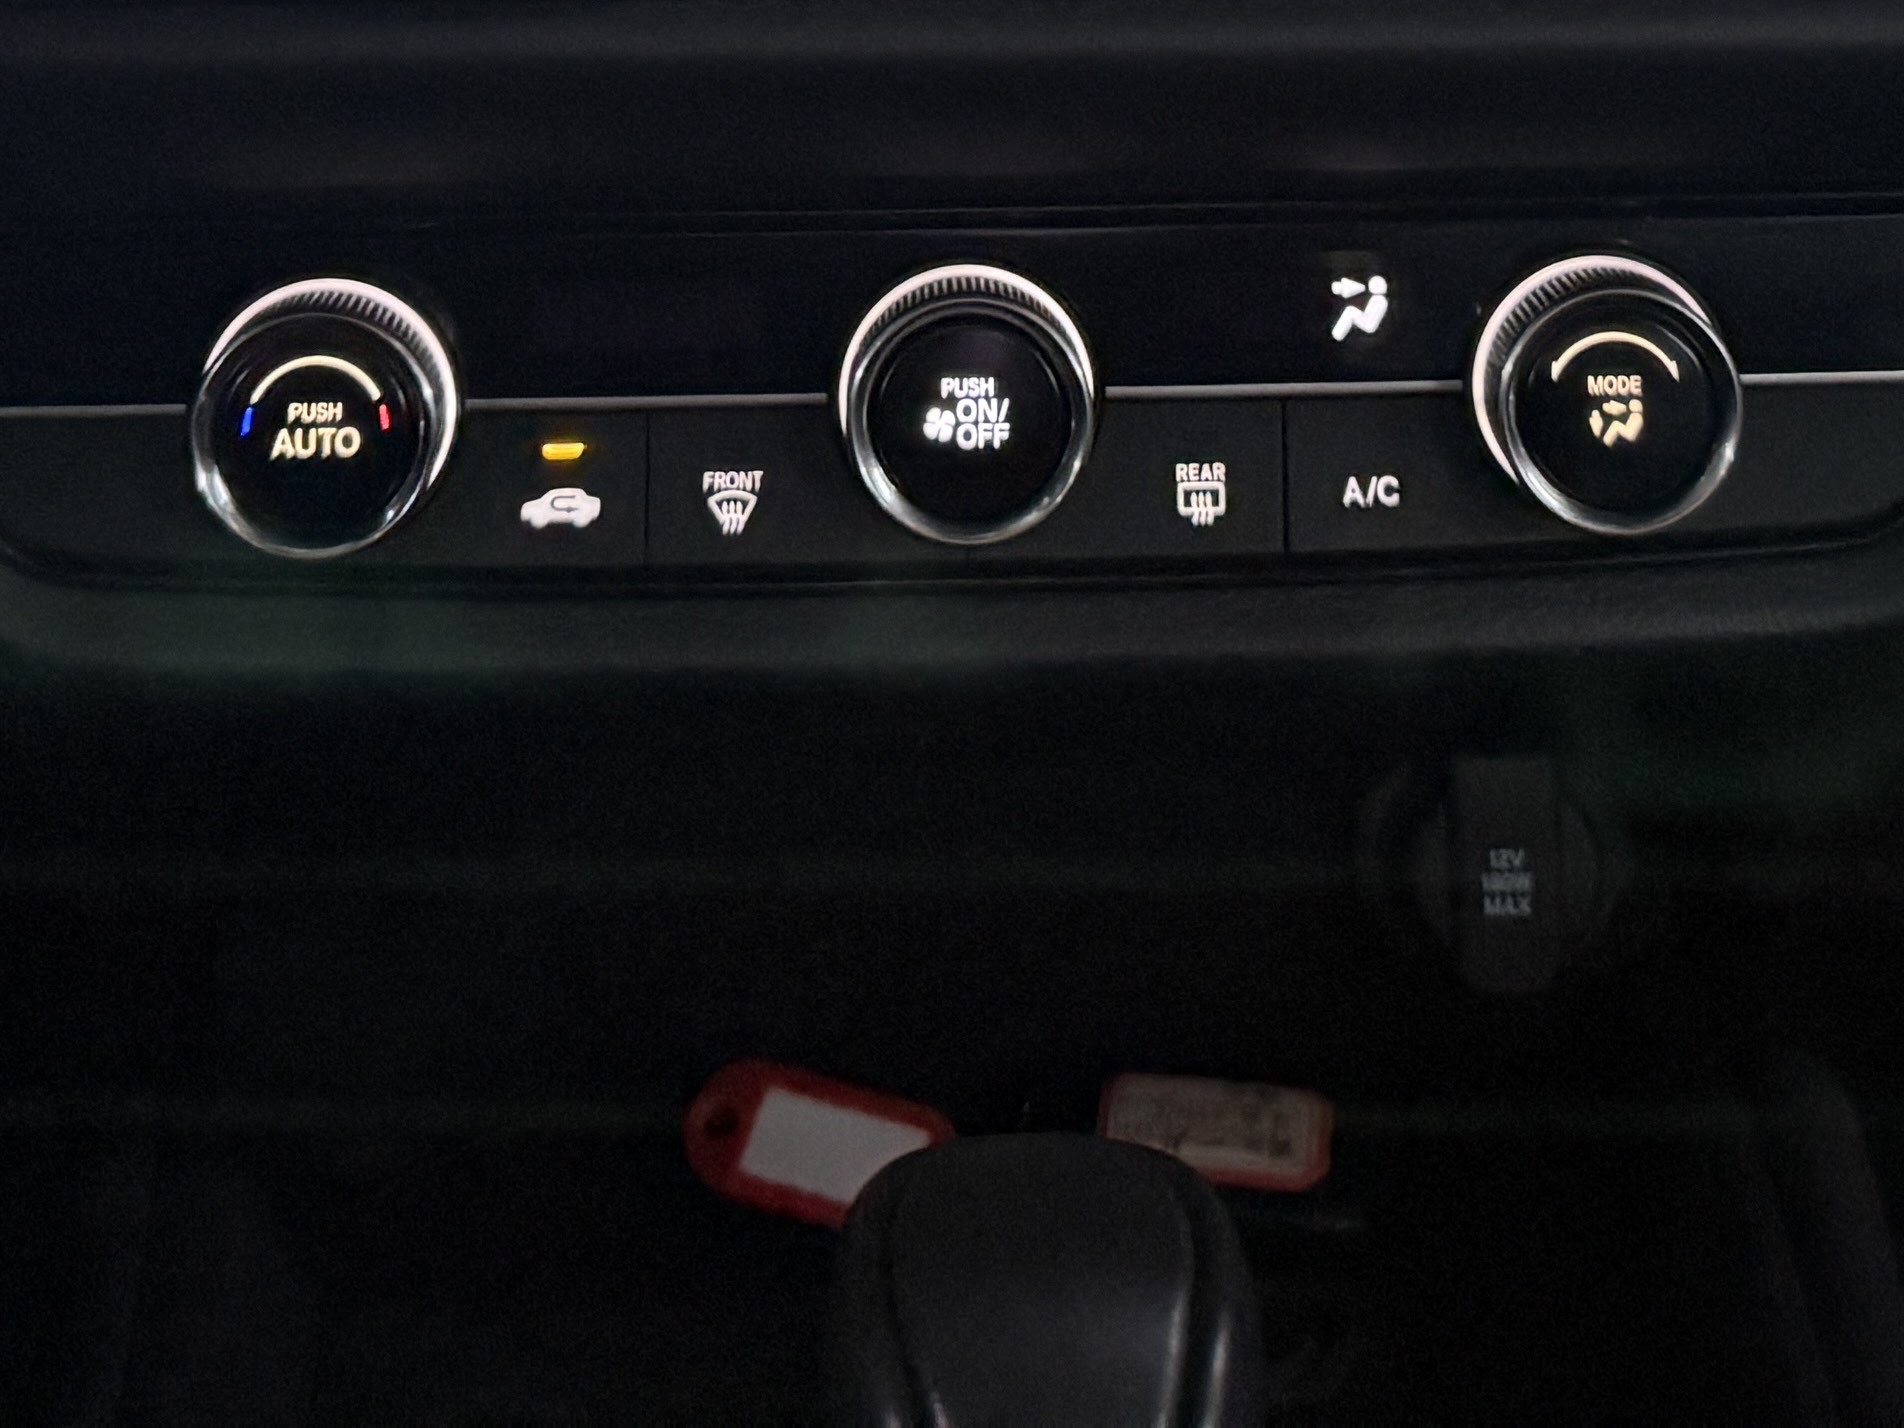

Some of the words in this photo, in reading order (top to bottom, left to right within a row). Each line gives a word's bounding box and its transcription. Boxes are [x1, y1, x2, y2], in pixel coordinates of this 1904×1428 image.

[940, 376, 996, 397] PUSH
[1587, 374, 1642, 397] MODE
[287, 401, 344, 424] PUSH
[270, 425, 362, 460] AUTO
[955, 423, 1011, 450] OFF
[702, 470, 764, 492] FRONT
[1175, 461, 1227, 481] REAR
[1342, 474, 1400, 507] A/C
